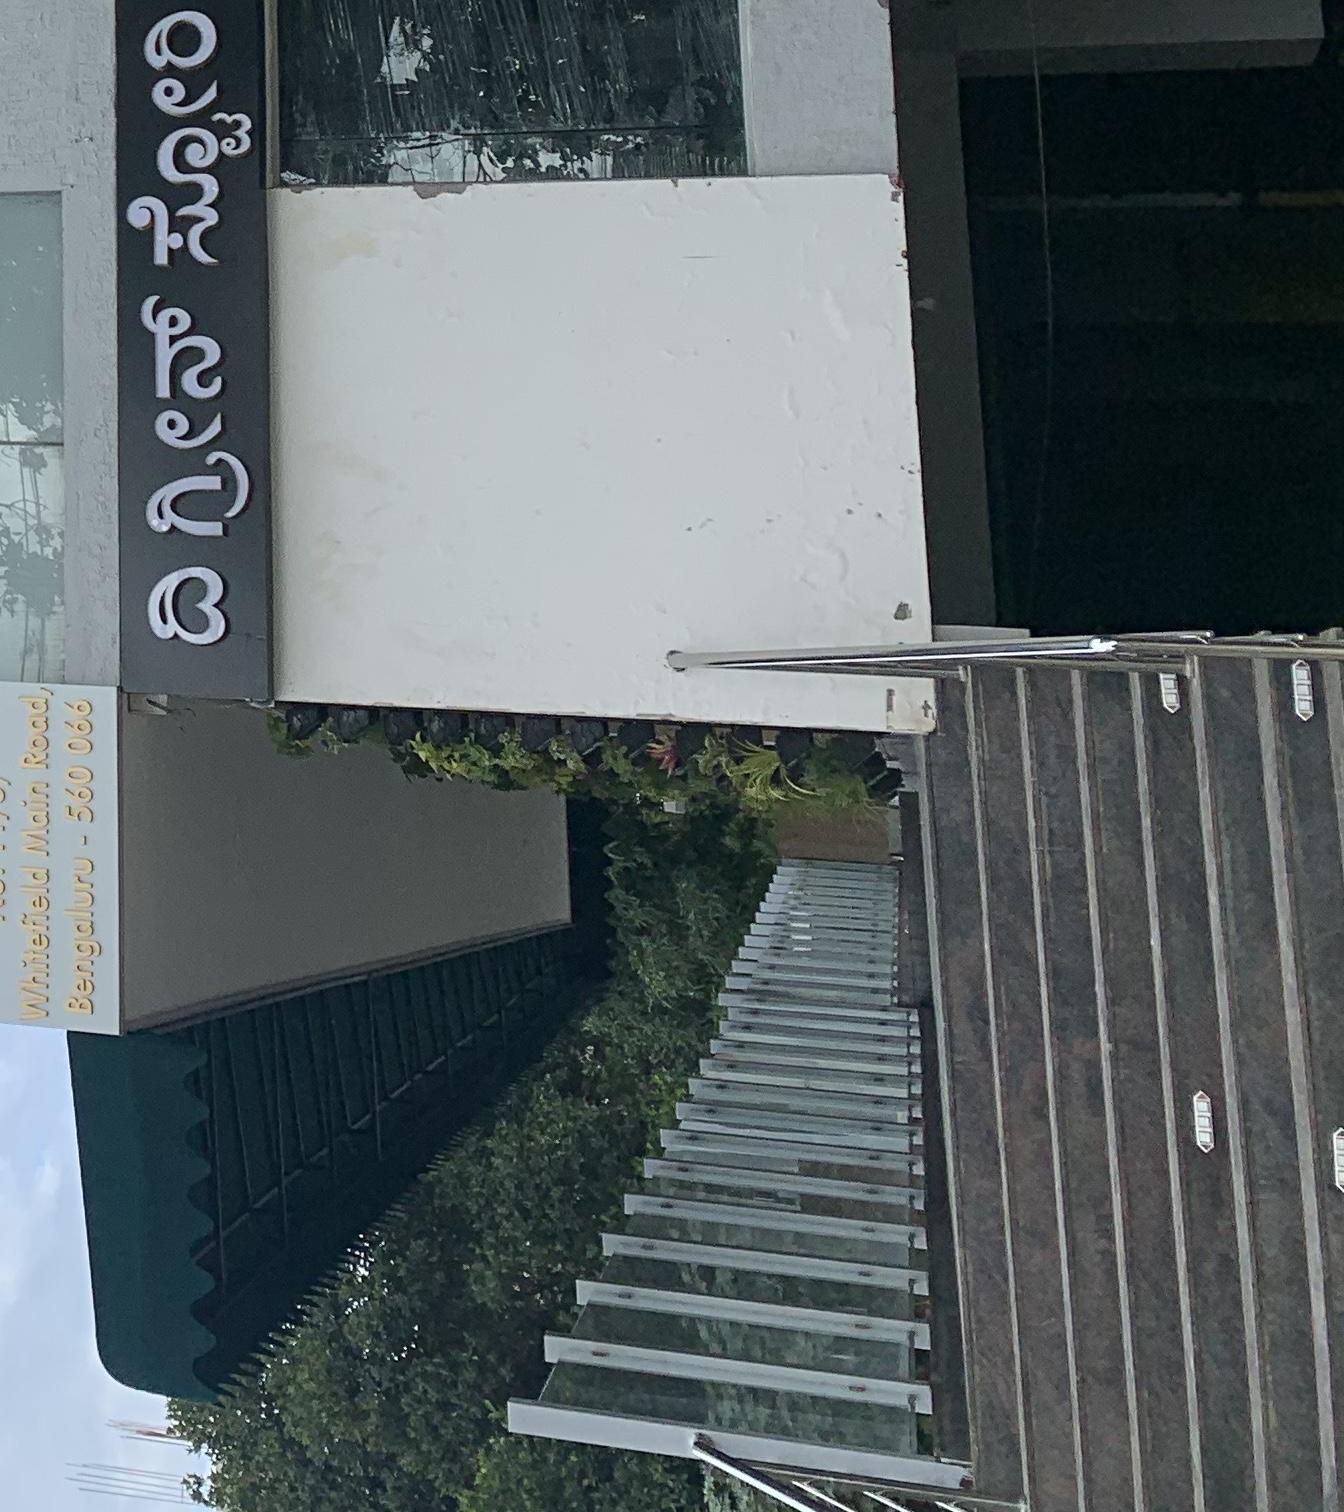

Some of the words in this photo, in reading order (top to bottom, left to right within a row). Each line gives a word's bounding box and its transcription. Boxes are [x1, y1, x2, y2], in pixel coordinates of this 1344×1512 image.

[125, 9, 252, 268] ಸ್ಟೋರಿ
[139, 294, 250, 538] ಗ್ರೀನ್
[146, 566, 227, 646] ದಿ
[17, 686, 54, 771] Road,
[63, 698, 94, 756] 066
[18, 781, 50, 857] Main
[63, 765, 94, 824] 560
[17, 865, 50, 1021] Whitefield
[62, 856, 102, 1016] Bengaluru
